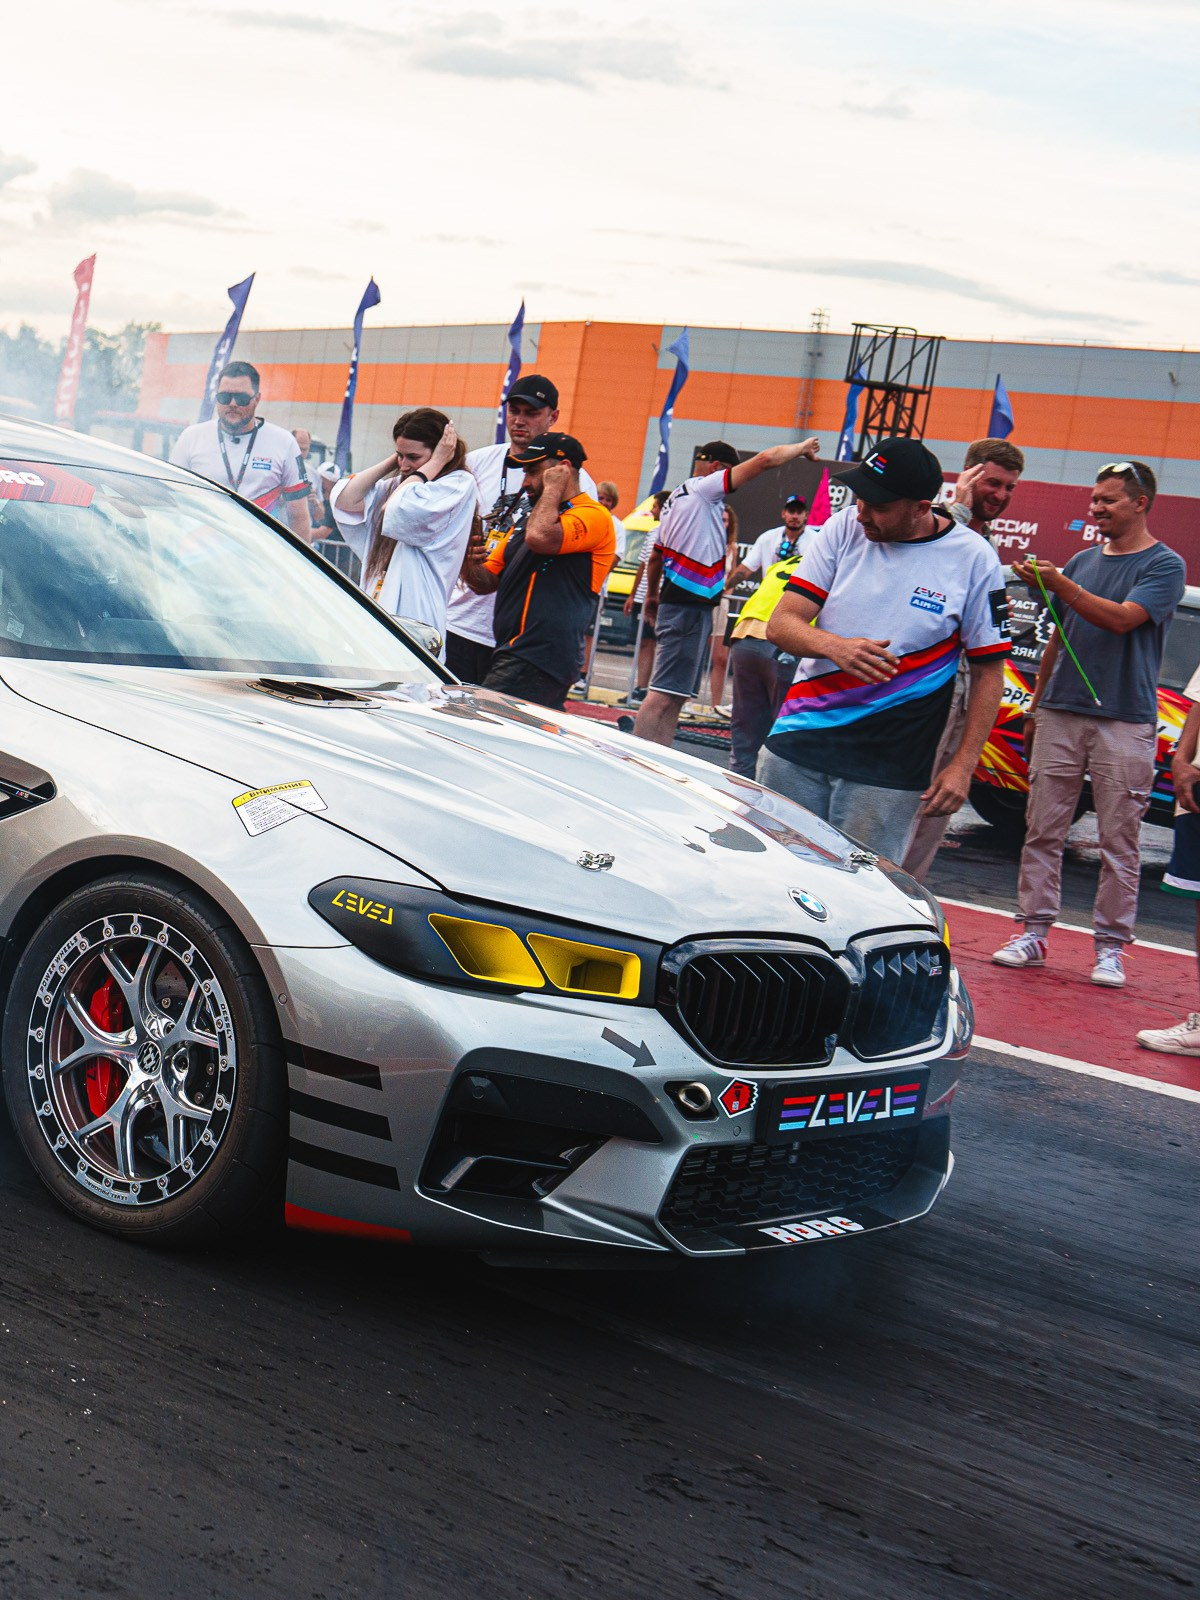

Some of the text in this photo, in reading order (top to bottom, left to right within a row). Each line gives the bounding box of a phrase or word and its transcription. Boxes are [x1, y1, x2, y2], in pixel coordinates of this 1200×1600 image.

[1011, 645, 1038, 659] ЗЯН
[249, 781, 304, 798] ВНИМАНИЕ
[332, 889, 395, 926] LEVEL
[40, 935, 79, 993] POWER WHEELS
[758, 1215, 865, 1244] RDRC
